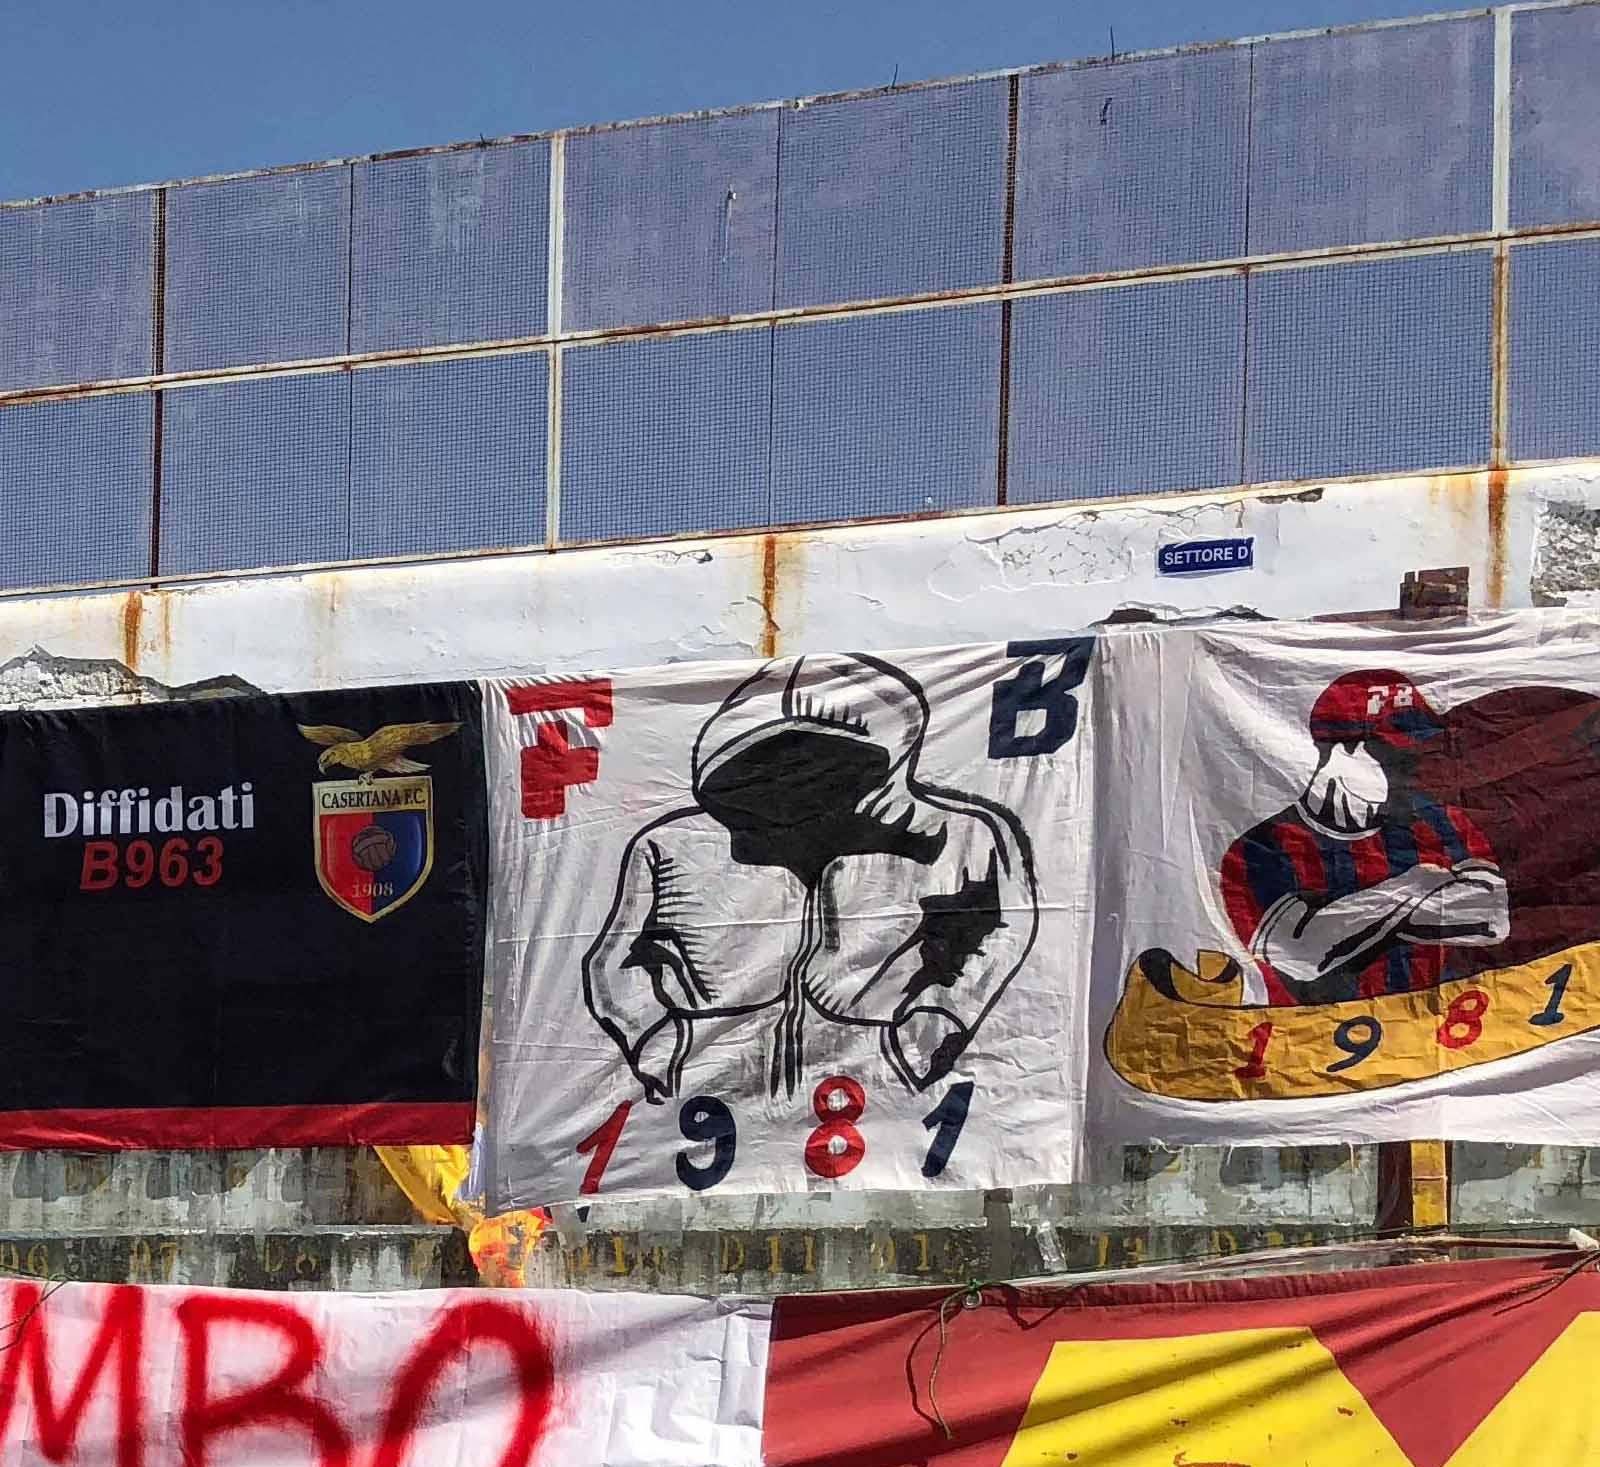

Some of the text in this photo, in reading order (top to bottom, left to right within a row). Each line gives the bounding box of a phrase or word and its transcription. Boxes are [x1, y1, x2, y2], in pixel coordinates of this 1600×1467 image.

[1164, 546, 1249, 566] SETTORE D
[506, 636, 1096, 820] F B
[43, 783, 255, 840] Diffidati
[321, 789, 400, 809] CASERTANA
[80, 840, 224, 890] B963
[351, 881, 394, 898] 1908
[1234, 963, 1573, 1079] 1981
[576, 1075, 974, 1194] 1981
